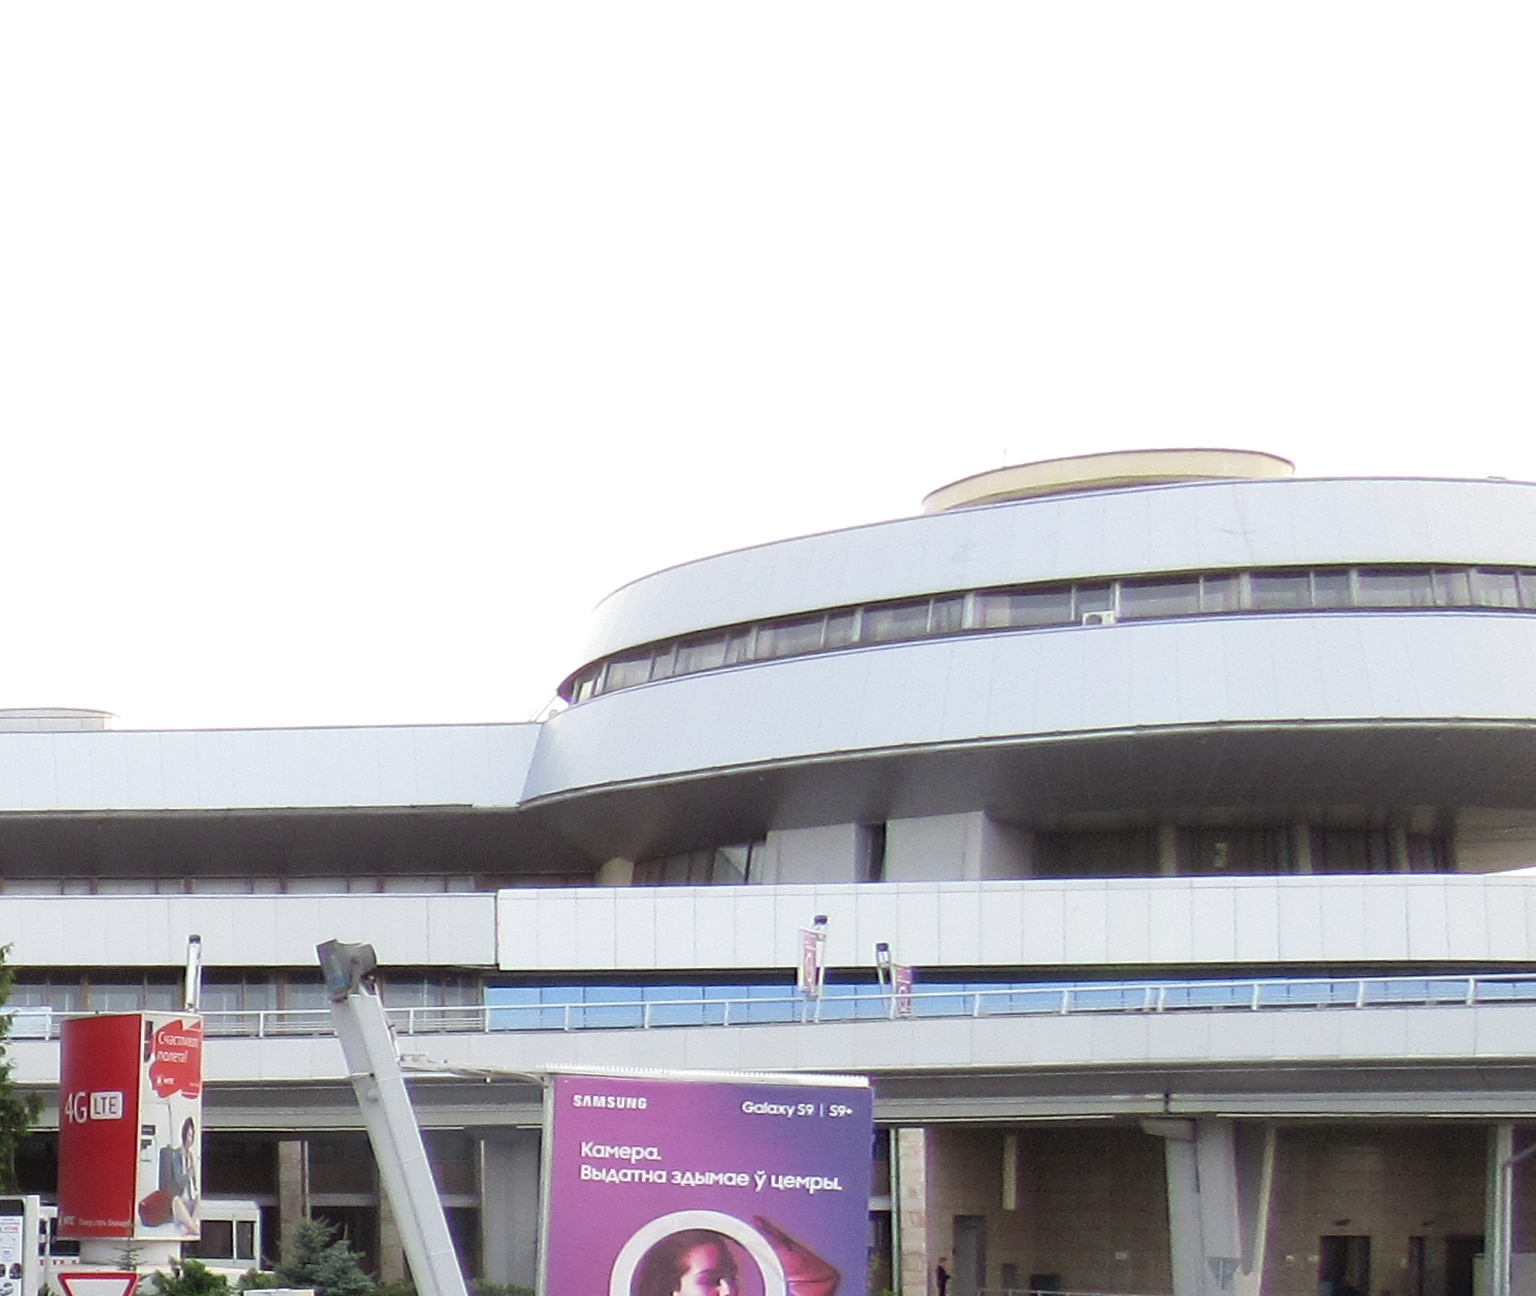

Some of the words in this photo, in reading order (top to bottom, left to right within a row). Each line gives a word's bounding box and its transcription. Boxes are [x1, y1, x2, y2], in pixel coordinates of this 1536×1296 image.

[64, 1091, 87, 1123] 4G
[94, 1096, 118, 1115] LTE
[572, 1094, 648, 1110] SAMSUNG
[742, 1101, 796, 1118] Galaxy
[797, 1103, 814, 1116] S9
[580, 1141, 662, 1163] Камера.
[580, 1164, 667, 1184] Выдатна
[671, 1169, 750, 1187] здымае
[754, 1170, 768, 1192] ў
[771, 1174, 843, 1195] цемры.
